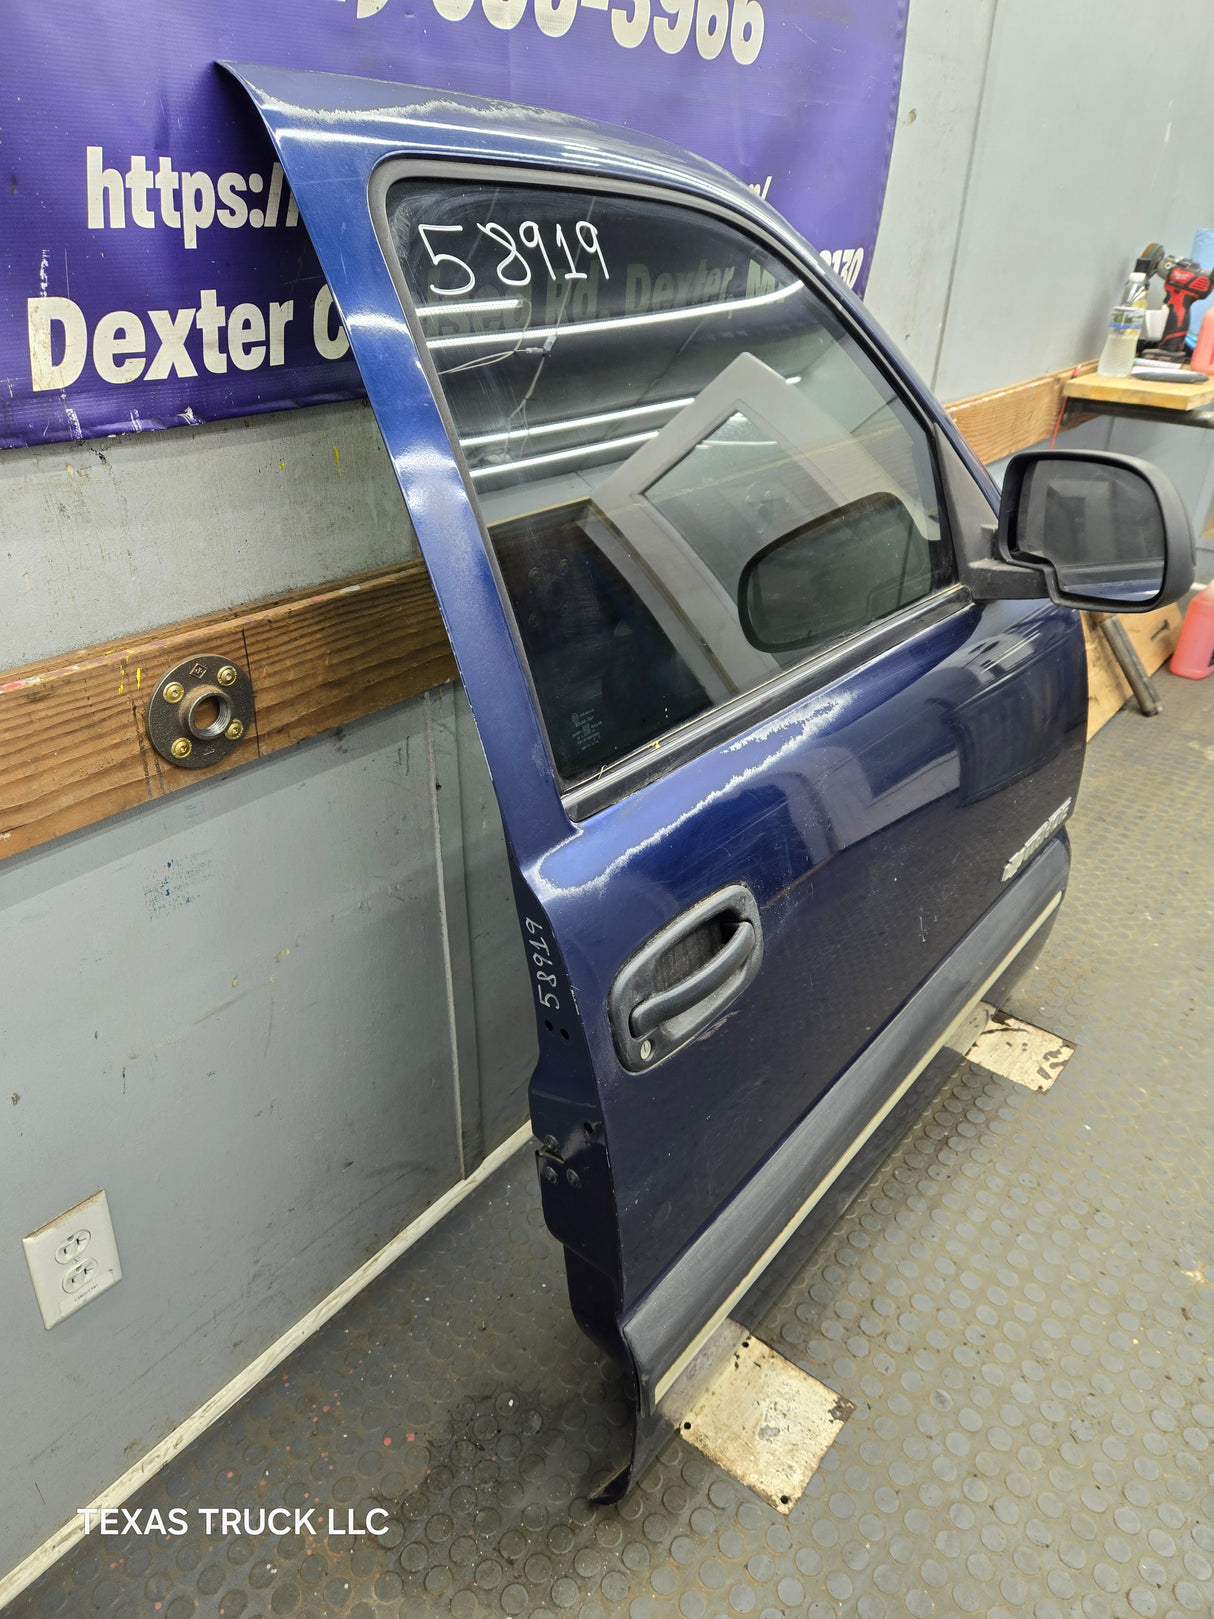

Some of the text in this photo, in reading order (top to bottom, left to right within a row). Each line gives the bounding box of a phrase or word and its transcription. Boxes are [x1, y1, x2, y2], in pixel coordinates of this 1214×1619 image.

[418, 221, 610, 295] 58919
[27, 289, 294, 392] Dexter
[525, 917, 560, 1010] 58919
